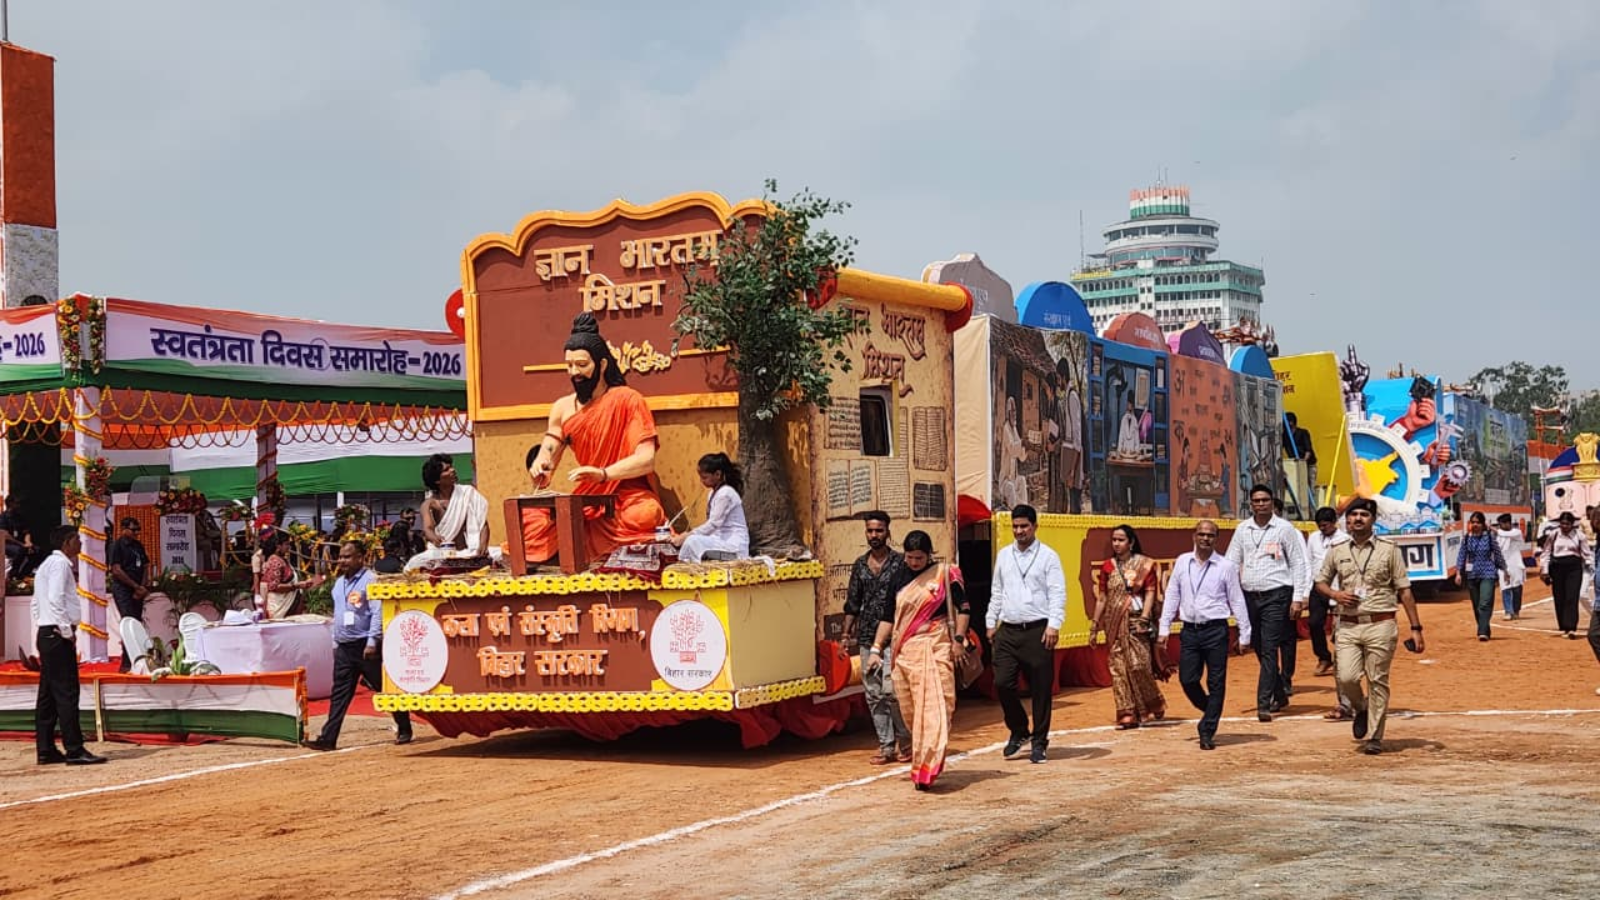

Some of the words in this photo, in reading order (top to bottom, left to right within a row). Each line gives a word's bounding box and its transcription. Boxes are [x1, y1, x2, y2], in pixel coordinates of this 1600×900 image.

[533, 244, 593, 281] ज्ञान
[578, 273, 666, 313] मिशन
[0, 331, 46, 357] -2026
[150, 324, 255, 364] स्वतंत्रता
[260, 329, 323, 369] दिवस
[441, 613, 480, 638] कला
[484, 605, 513, 637] एवं
[517, 604, 582, 643] संस्कृति
[476, 645, 526, 679] बिहार
[533, 650, 609, 676] सरकार
[664, 666, 685, 678] बिहार
[687, 669, 713, 679] सरकार
